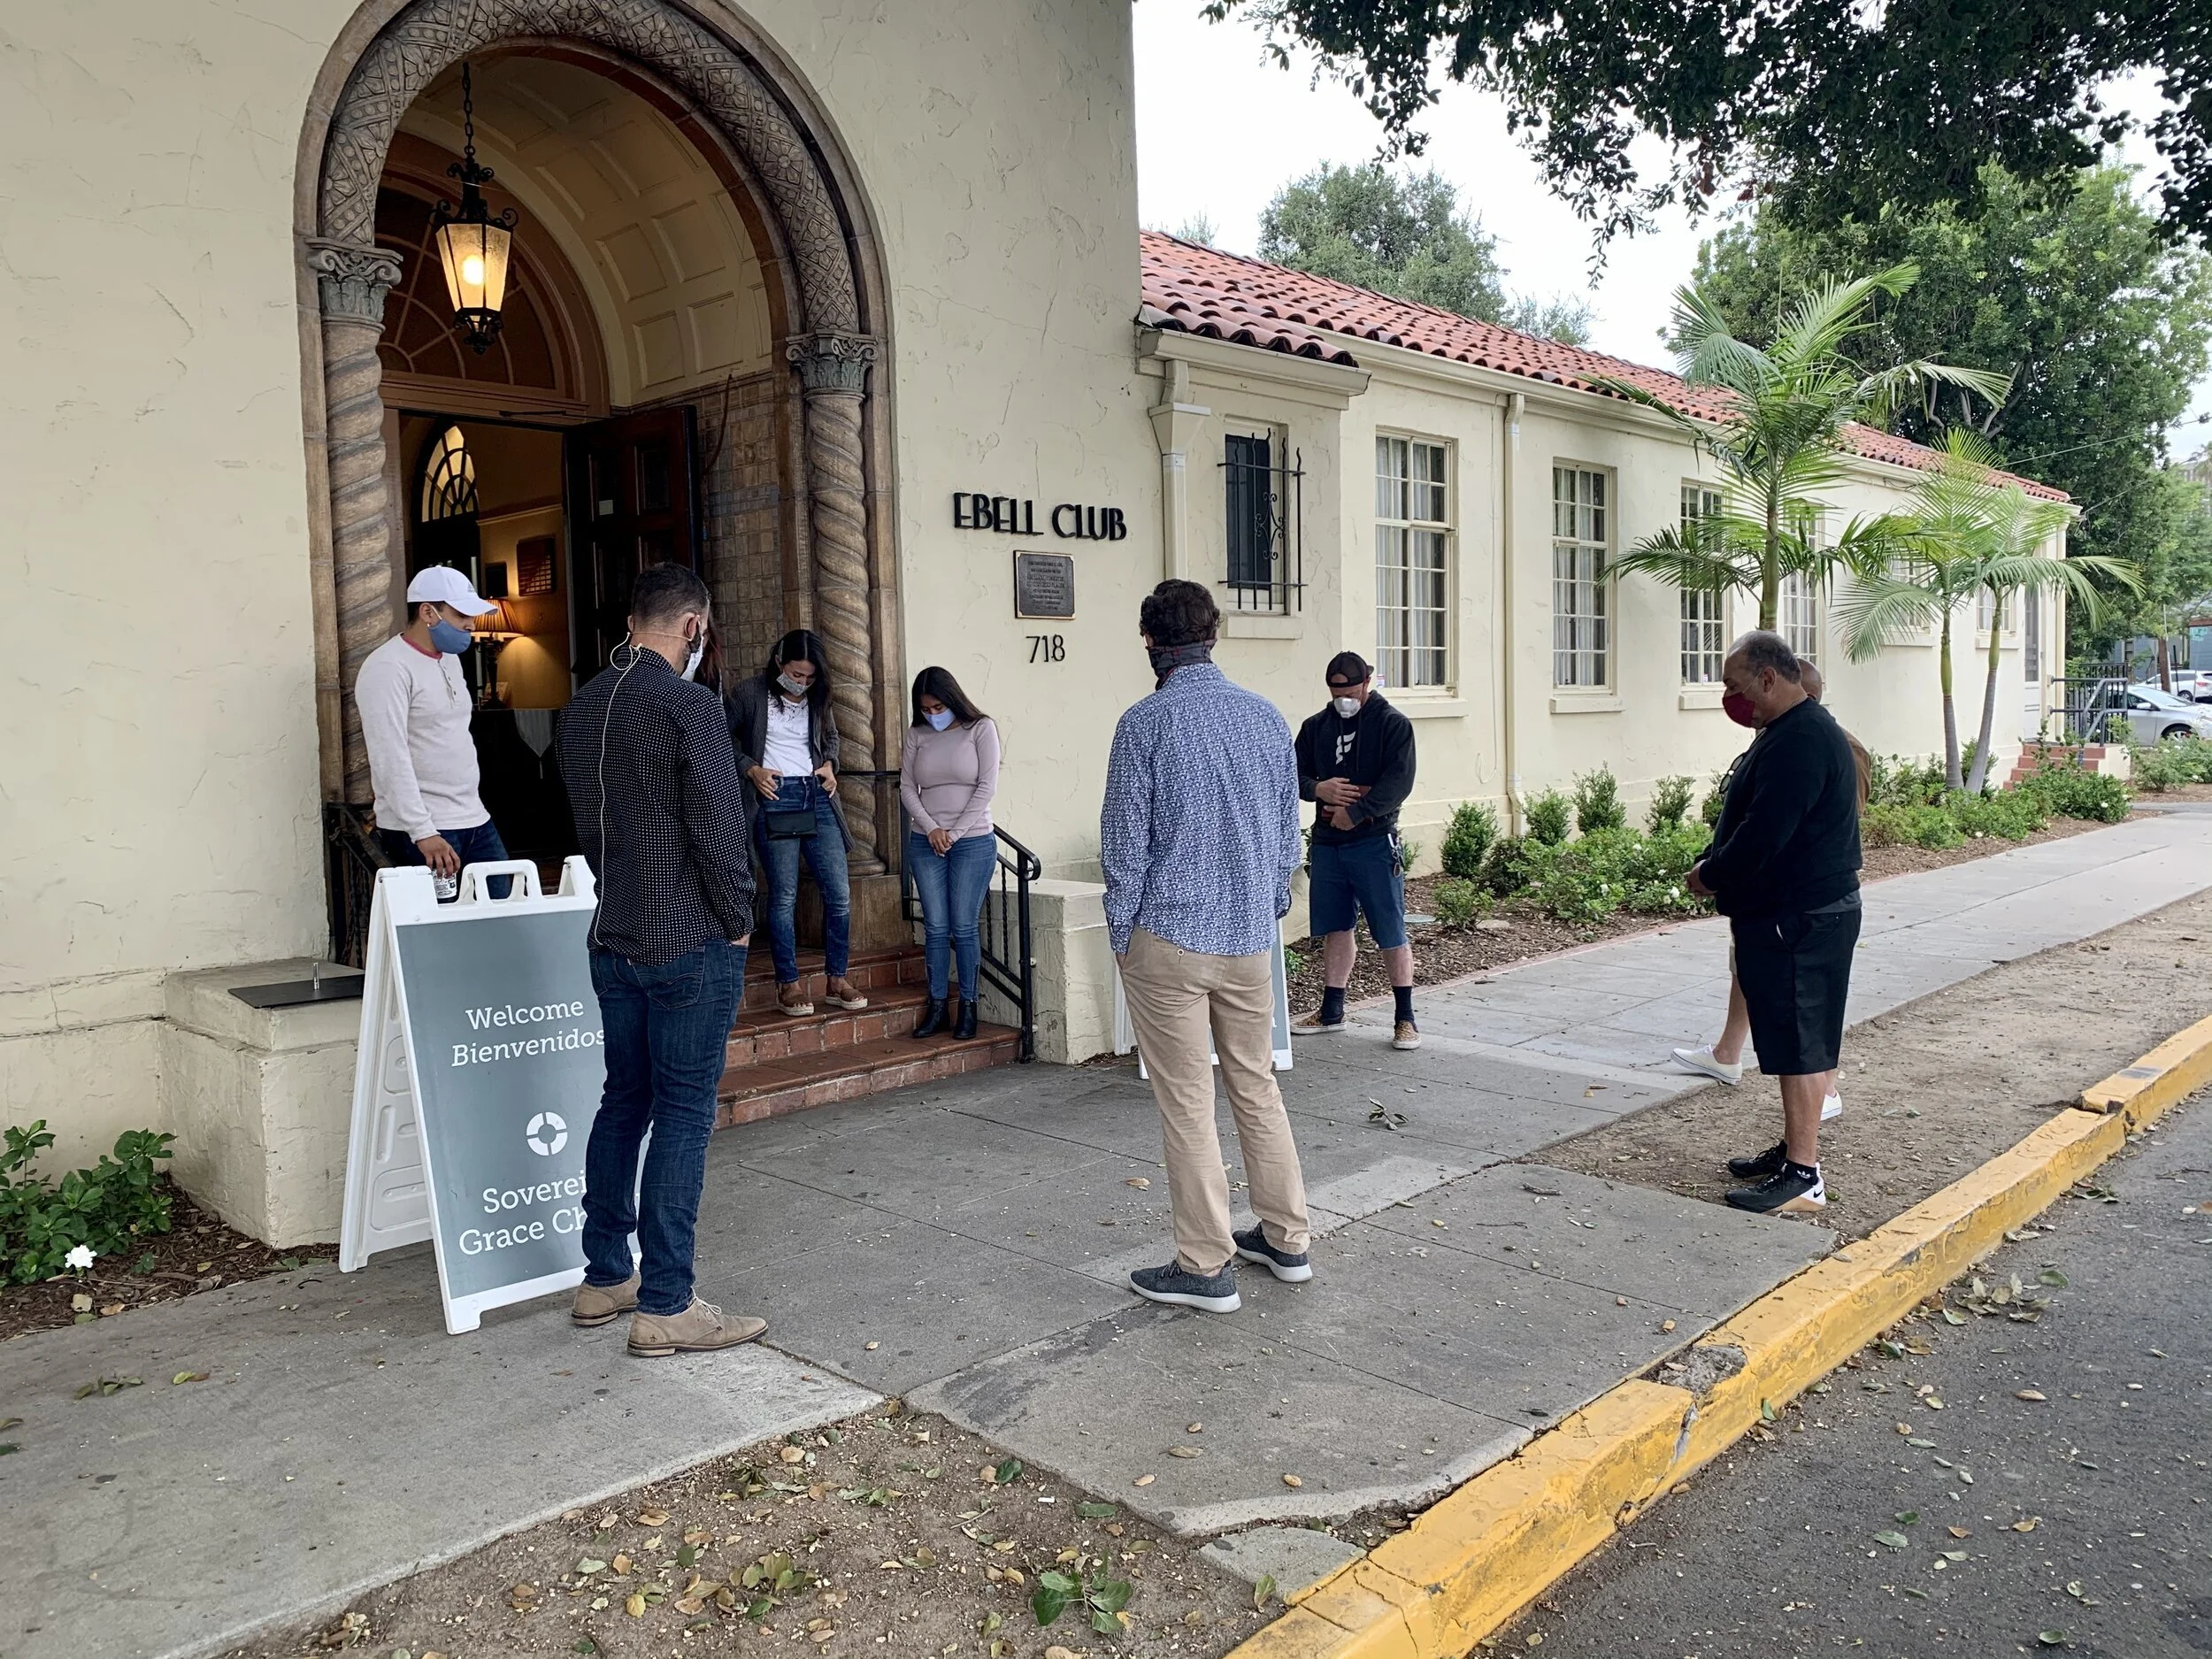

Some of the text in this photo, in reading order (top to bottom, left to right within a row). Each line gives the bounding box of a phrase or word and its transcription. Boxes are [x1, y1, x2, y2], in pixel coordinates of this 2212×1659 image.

[954, 492, 1127, 541] EBELL CLUB
[1025, 634, 1065, 664] 718
[465, 1000, 585, 1031] Welcome
[451, 1028, 605, 1068] Bienvenidos
[459, 1220, 545, 1256] Grace
